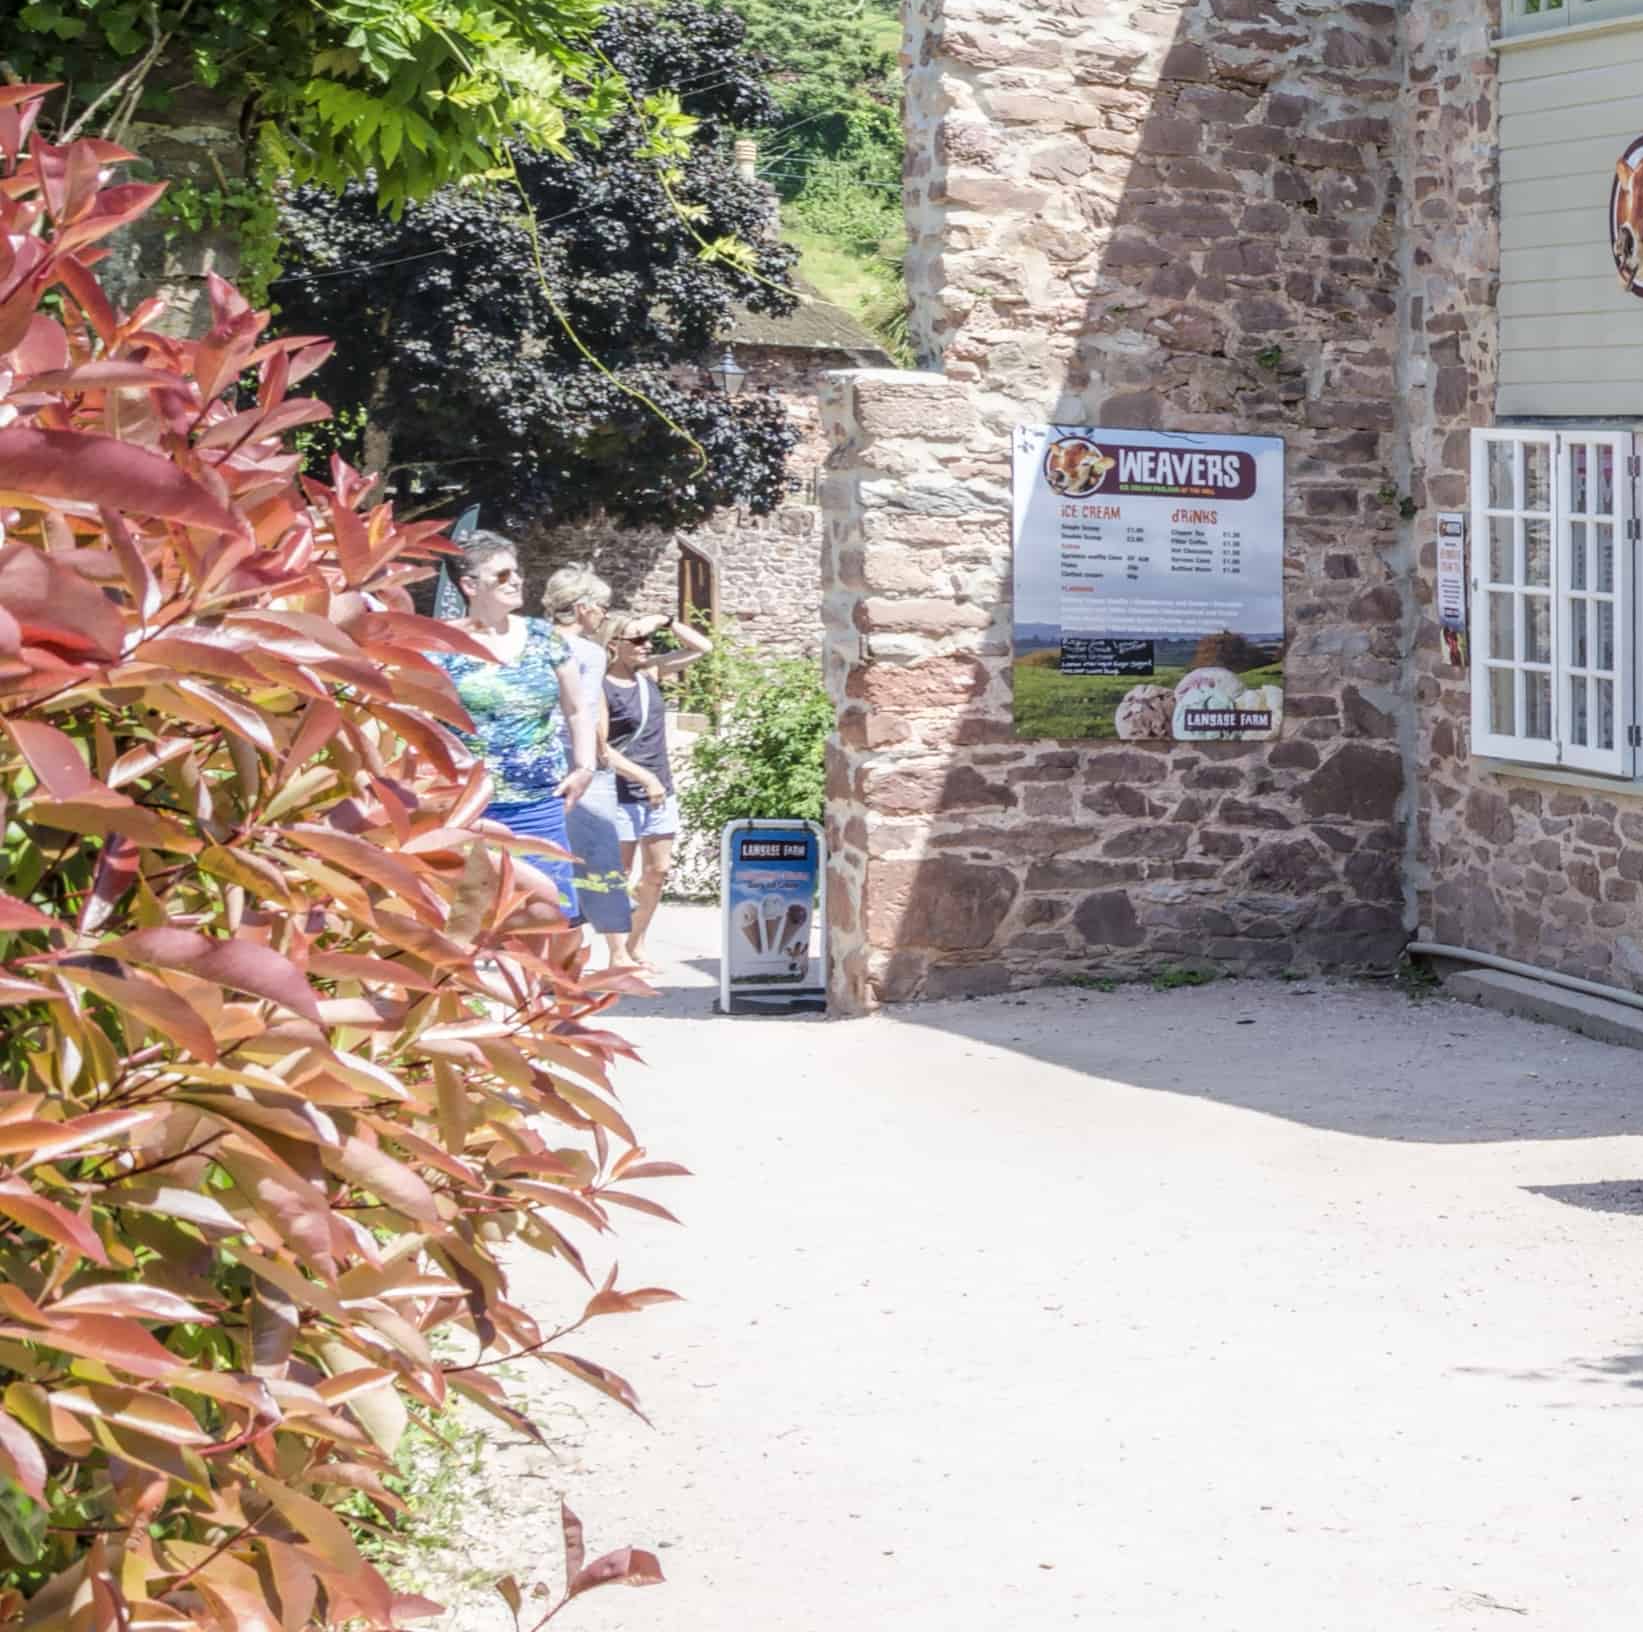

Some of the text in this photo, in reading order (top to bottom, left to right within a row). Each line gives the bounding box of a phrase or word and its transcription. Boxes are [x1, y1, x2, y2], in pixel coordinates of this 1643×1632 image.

[1118, 448, 1241, 488] WEAVERS
[1081, 505, 1121, 520] CREAM
[1240, 713, 1269, 726] FARM
